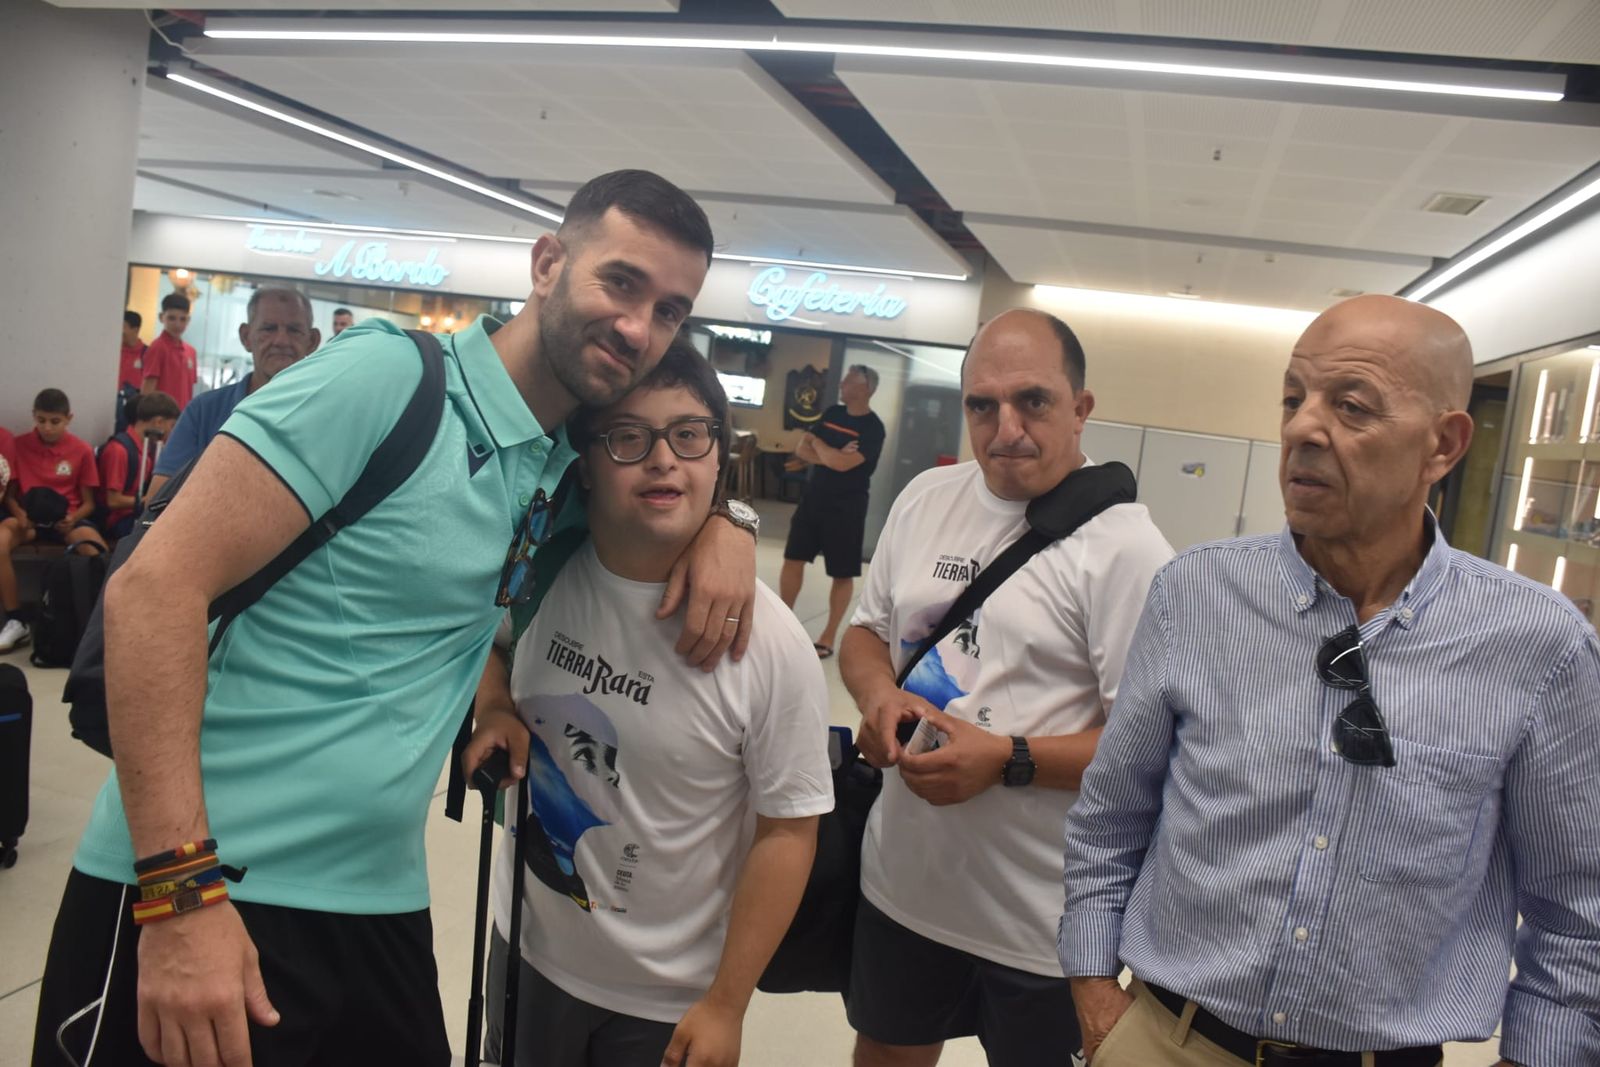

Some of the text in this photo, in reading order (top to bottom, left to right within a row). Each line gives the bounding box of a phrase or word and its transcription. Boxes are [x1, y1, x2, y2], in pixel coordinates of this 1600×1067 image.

[352, 241, 450, 287] Bordo
[546, 639, 652, 706] TIERRA Rara
